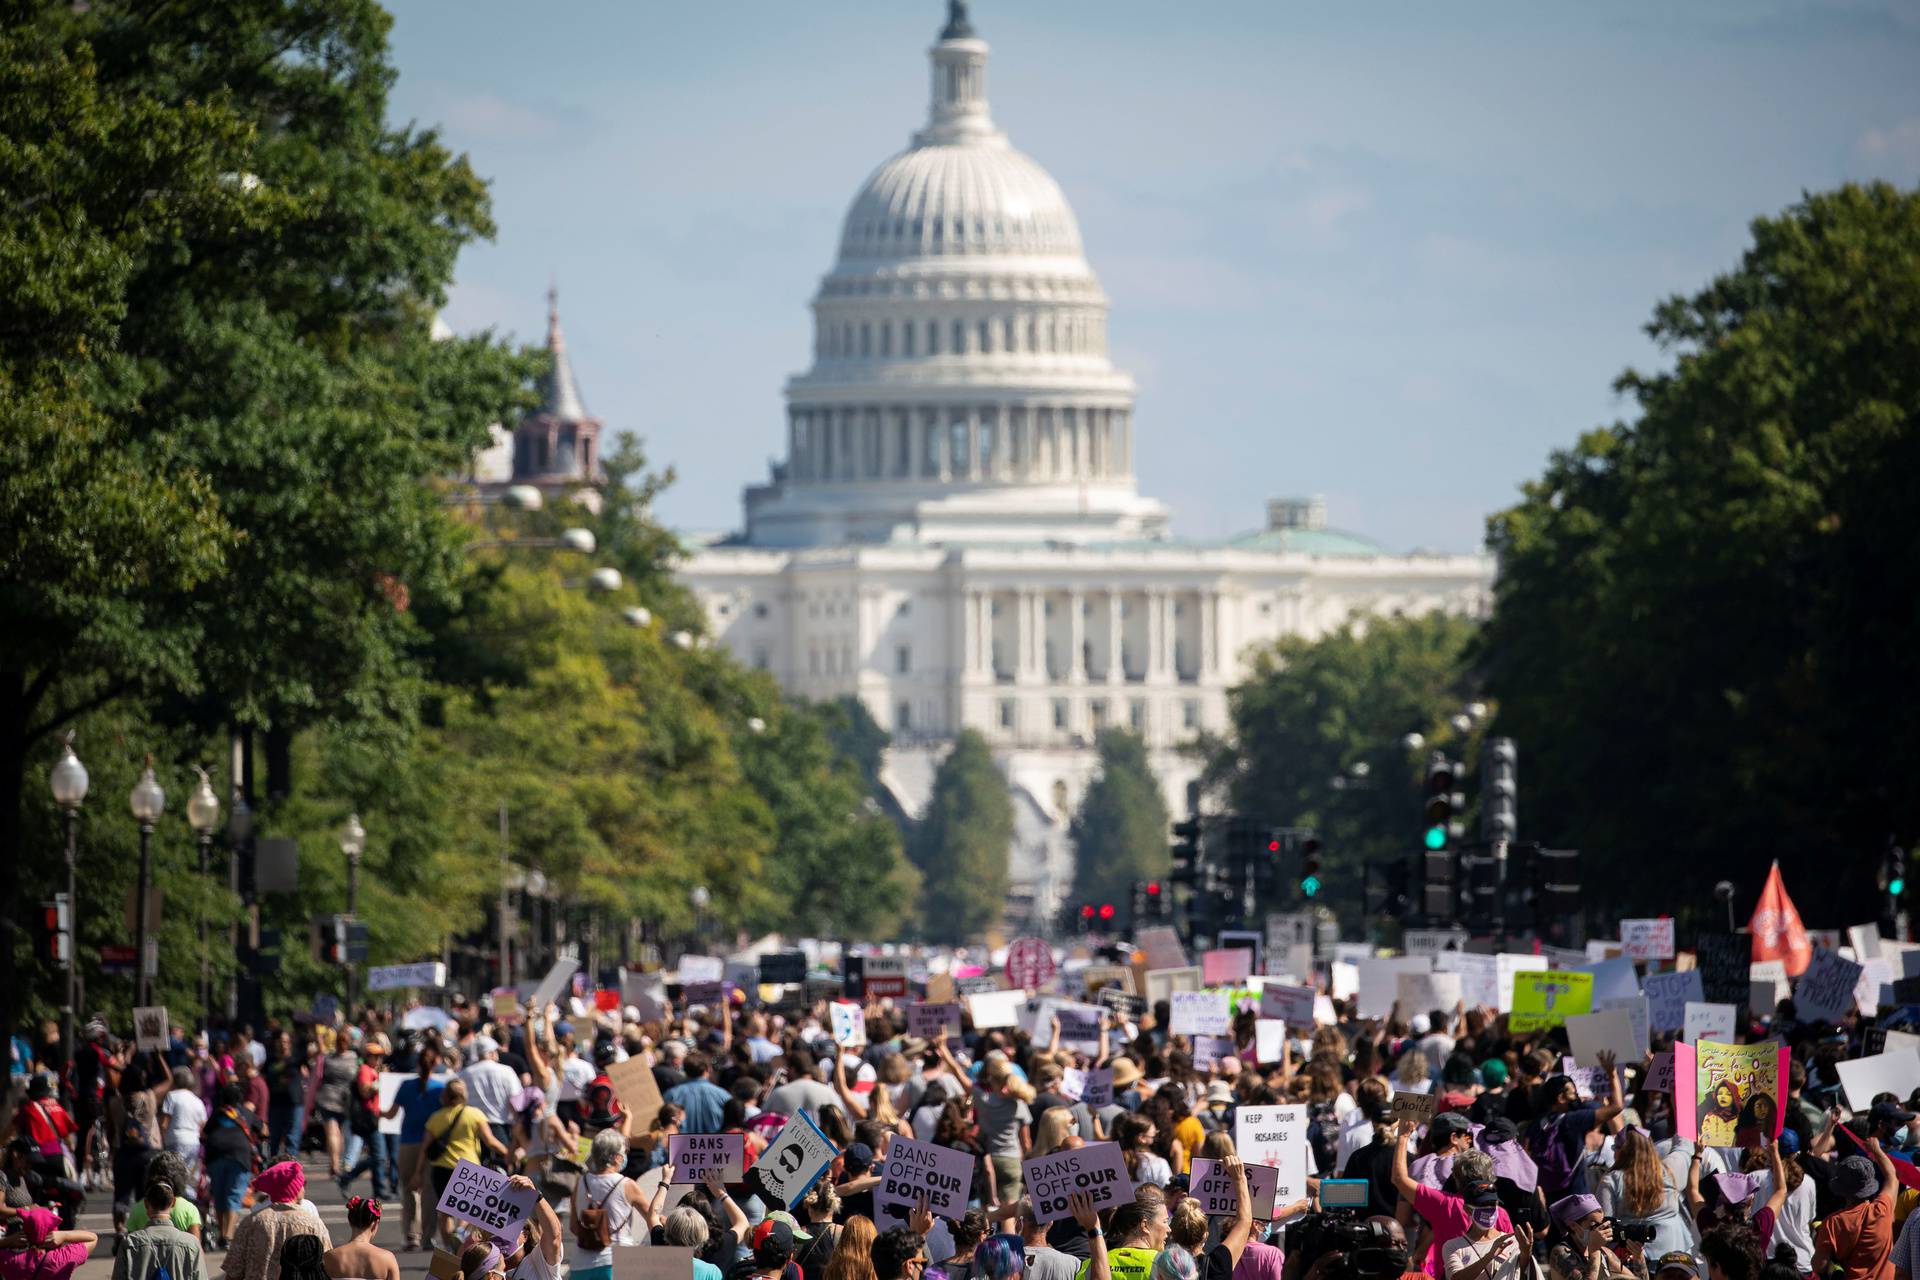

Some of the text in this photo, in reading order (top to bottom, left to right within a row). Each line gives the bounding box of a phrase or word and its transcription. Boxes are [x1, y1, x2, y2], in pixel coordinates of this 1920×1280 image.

[1645, 976, 1692, 999] STOP
[1245, 1112, 1295, 1124] KEEP YOUR
[690, 1138, 723, 1149] BANS
[789, 1125, 820, 1160] RUTHLESS
[1255, 1132, 1288, 1142] ROSARIES
[682, 1153, 731, 1165] OFF MY
[893, 1144, 937, 1168] BANS
[458, 1167, 501, 1193] BANS
[890, 1161, 961, 1193] OFF OUR
[1030, 1157, 1080, 1181] BANS
[1213, 1164, 1253, 1180] BAS
[1036, 1168, 1119, 1198] OFF OUR
[1203, 1180, 1231, 1193] OFF
[445, 1195, 506, 1229] BODIES
[453, 1182, 521, 1219] OFF OUR
